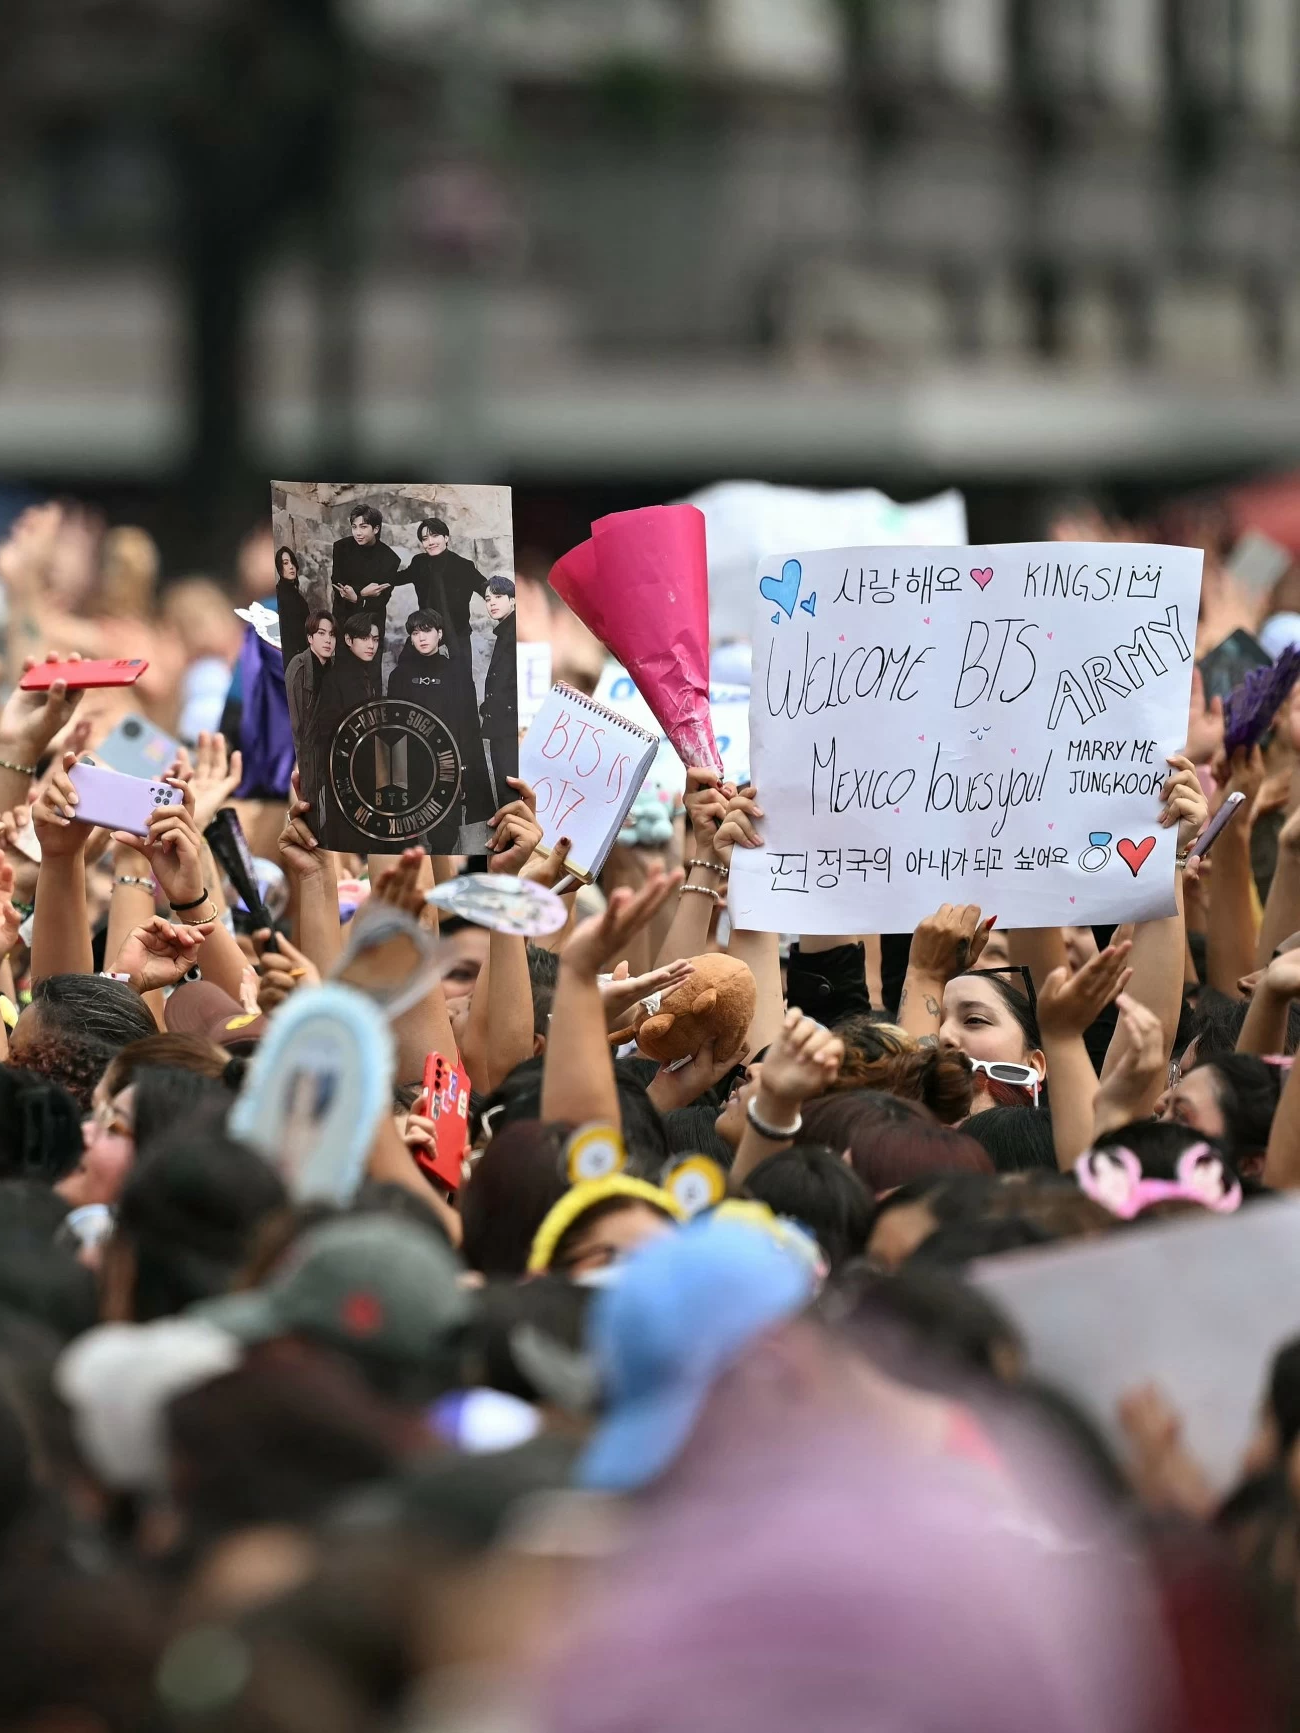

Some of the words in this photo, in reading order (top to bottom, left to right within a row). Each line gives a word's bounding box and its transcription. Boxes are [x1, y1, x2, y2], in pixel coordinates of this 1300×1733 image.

[1023, 562, 1122, 603] KINGS!
[766, 631, 937, 720] WELCOME
[954, 618, 1040, 709] BTS
[1046, 604, 1192, 731] ARMY
[349, 706, 388, 738] J-HOPE
[406, 710, 437, 738] SUGA
[541, 709, 606, 778] BTS
[1067, 739, 1128, 764] MARRY
[1131, 739, 1158, 765] ME
[437, 749, 456, 783] JIMIN
[353, 805, 373, 826] JIN
[375, 792, 408, 806] BTS
[388, 797, 444, 835] JUNGKOOK
[531, 776, 586, 831] OT7
